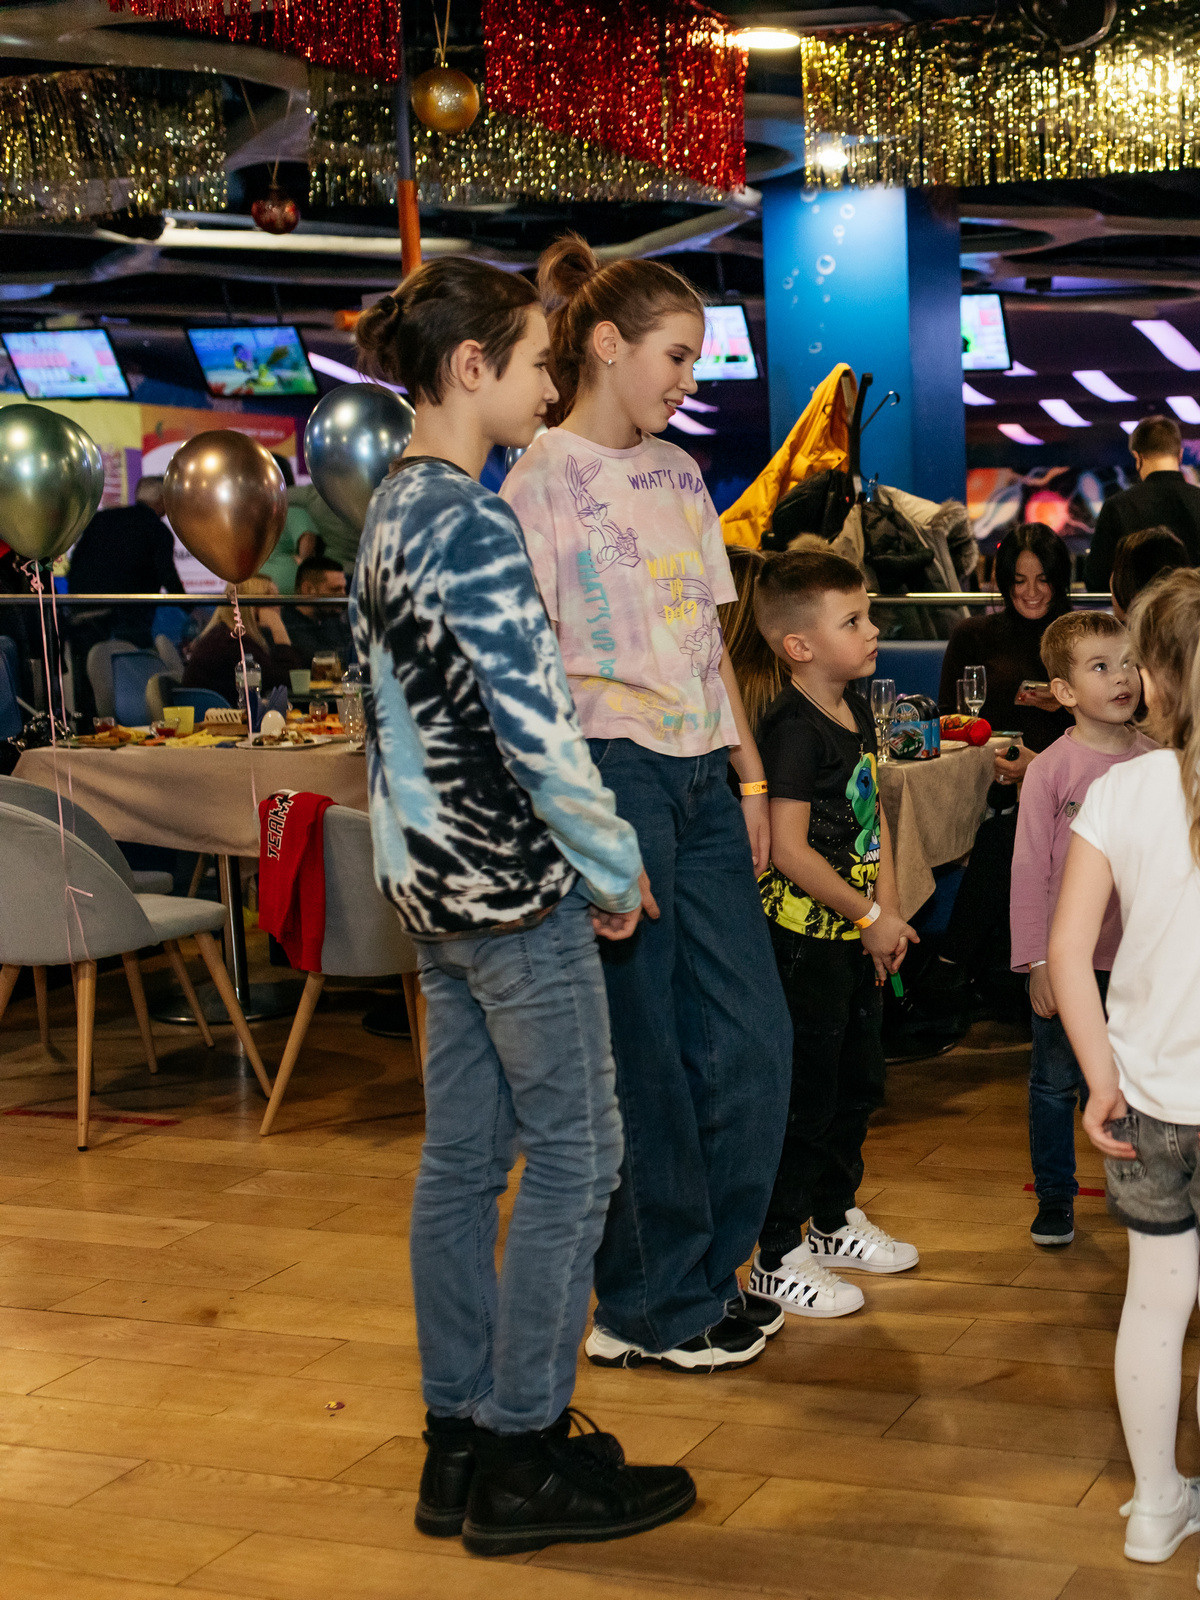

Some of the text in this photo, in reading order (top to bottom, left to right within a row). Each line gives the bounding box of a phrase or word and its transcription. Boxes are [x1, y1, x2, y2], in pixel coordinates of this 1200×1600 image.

[627, 469, 675, 490] WHAT'S
[678, 472, 693, 491] UP
[577, 550, 611, 624] WHAT'S
[670, 578, 684, 601] UP
[591, 629, 616, 652] UP
